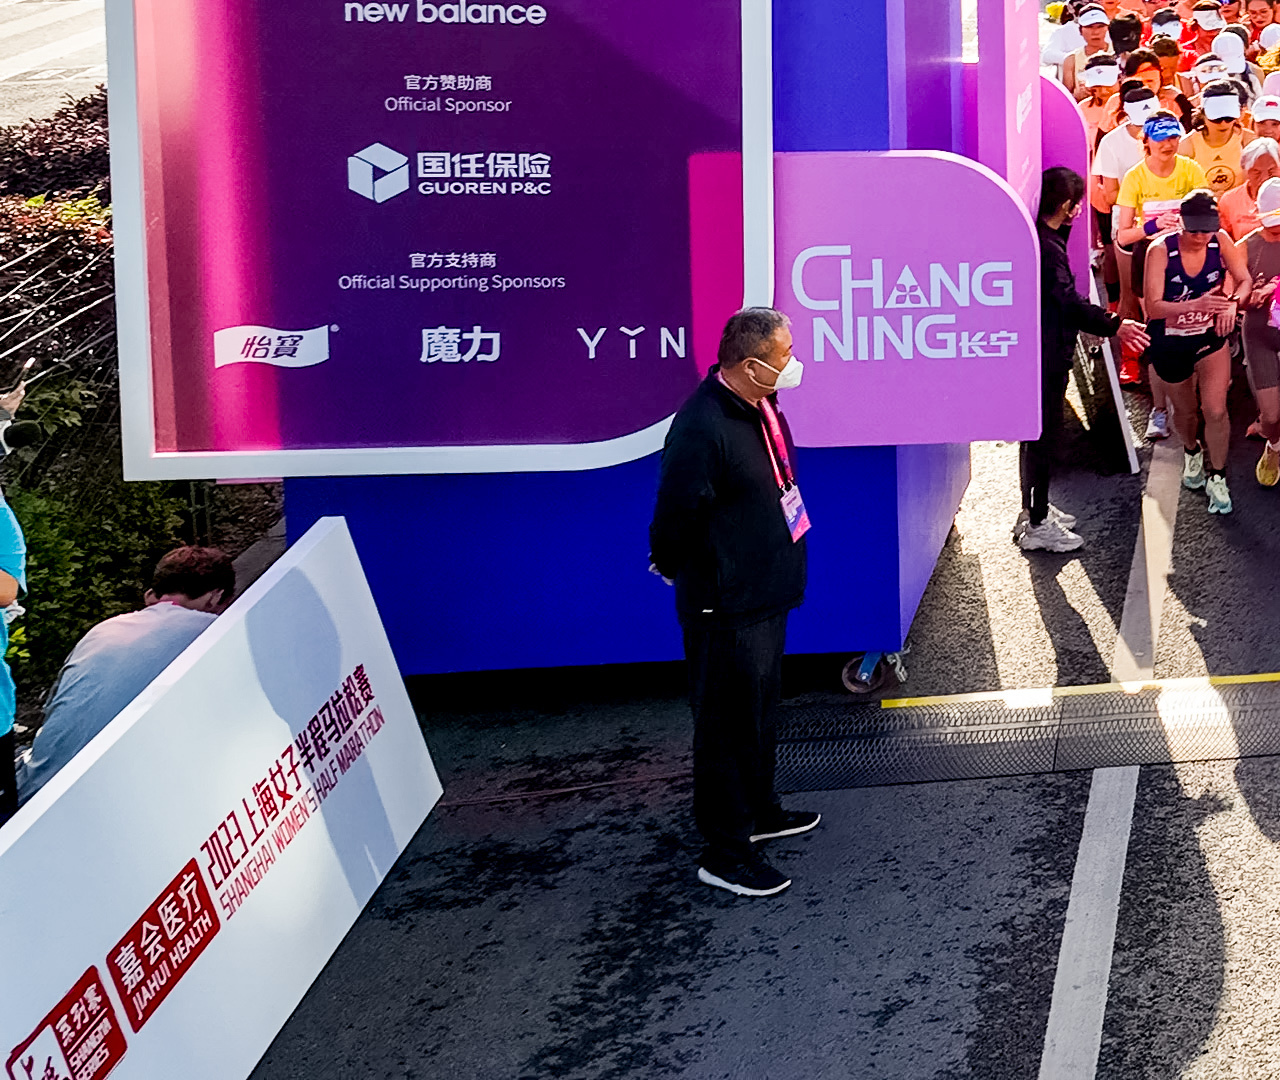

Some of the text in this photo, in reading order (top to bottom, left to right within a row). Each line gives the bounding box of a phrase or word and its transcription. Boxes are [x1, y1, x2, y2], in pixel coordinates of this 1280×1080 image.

[344, 0, 410, 22] new
[403, 74, 492, 92] 官方赞助商
[384, 96, 512, 115] Official Sponsor
[416, 152, 552, 180] 国任保险
[417, 181, 552, 196] GUOREN P&C
[408, 252, 497, 270] 官方支持商
[338, 274, 566, 293] Official Supporting Sponsors
[791, 245, 1014, 312] CHANG
[419, 325, 502, 364] 魔力
[812, 314, 957, 363] NING
[200, 663, 376, 891] 2023 上海女子半程马拉松赛
[219, 704, 386, 921] SHANGHAI WOMEN'S HALF MARATHON
[113, 872, 204, 995] 嘉会医疗
[132, 909, 214, 1021] JIAHUI HEALTH
